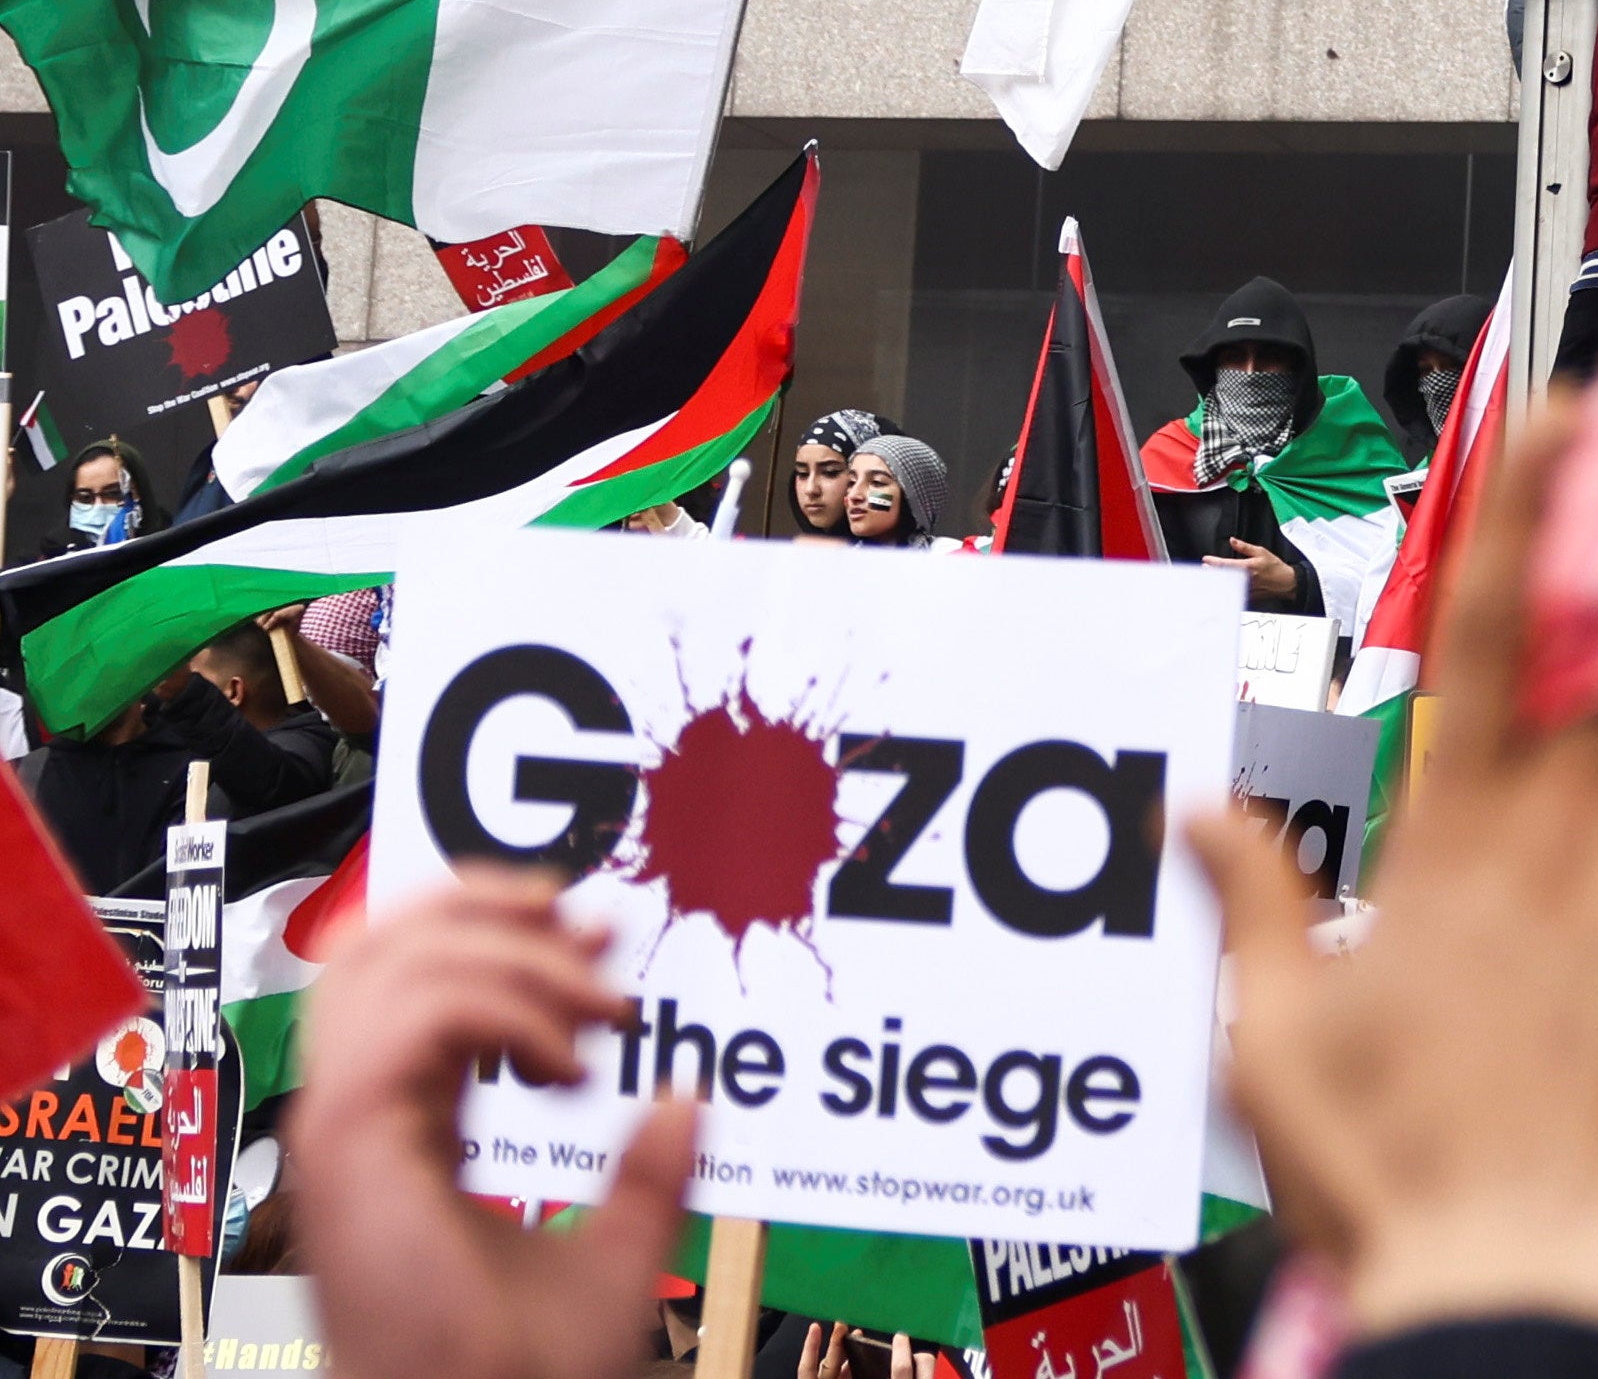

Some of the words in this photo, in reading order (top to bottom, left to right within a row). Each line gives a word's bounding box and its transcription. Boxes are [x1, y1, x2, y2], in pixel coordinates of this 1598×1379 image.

[461, 230, 526, 271] الحرية
[57, 229, 302, 359] Palene
[476, 255, 549, 307] لفلسطين
[414, 641, 1170, 943] Gza
[606, 995, 788, 1111] the
[818, 1014, 1144, 1163] siege
[0, 1091, 163, 1148] SRAEL
[66, 1153, 163, 1190] CRIM
[492, 1136, 538, 1166] the
[549, 1140, 607, 1174] War
[771, 1162, 1097, 1216] www.stopwar.org.uk
[37, 1195, 165, 1251] GAZ
